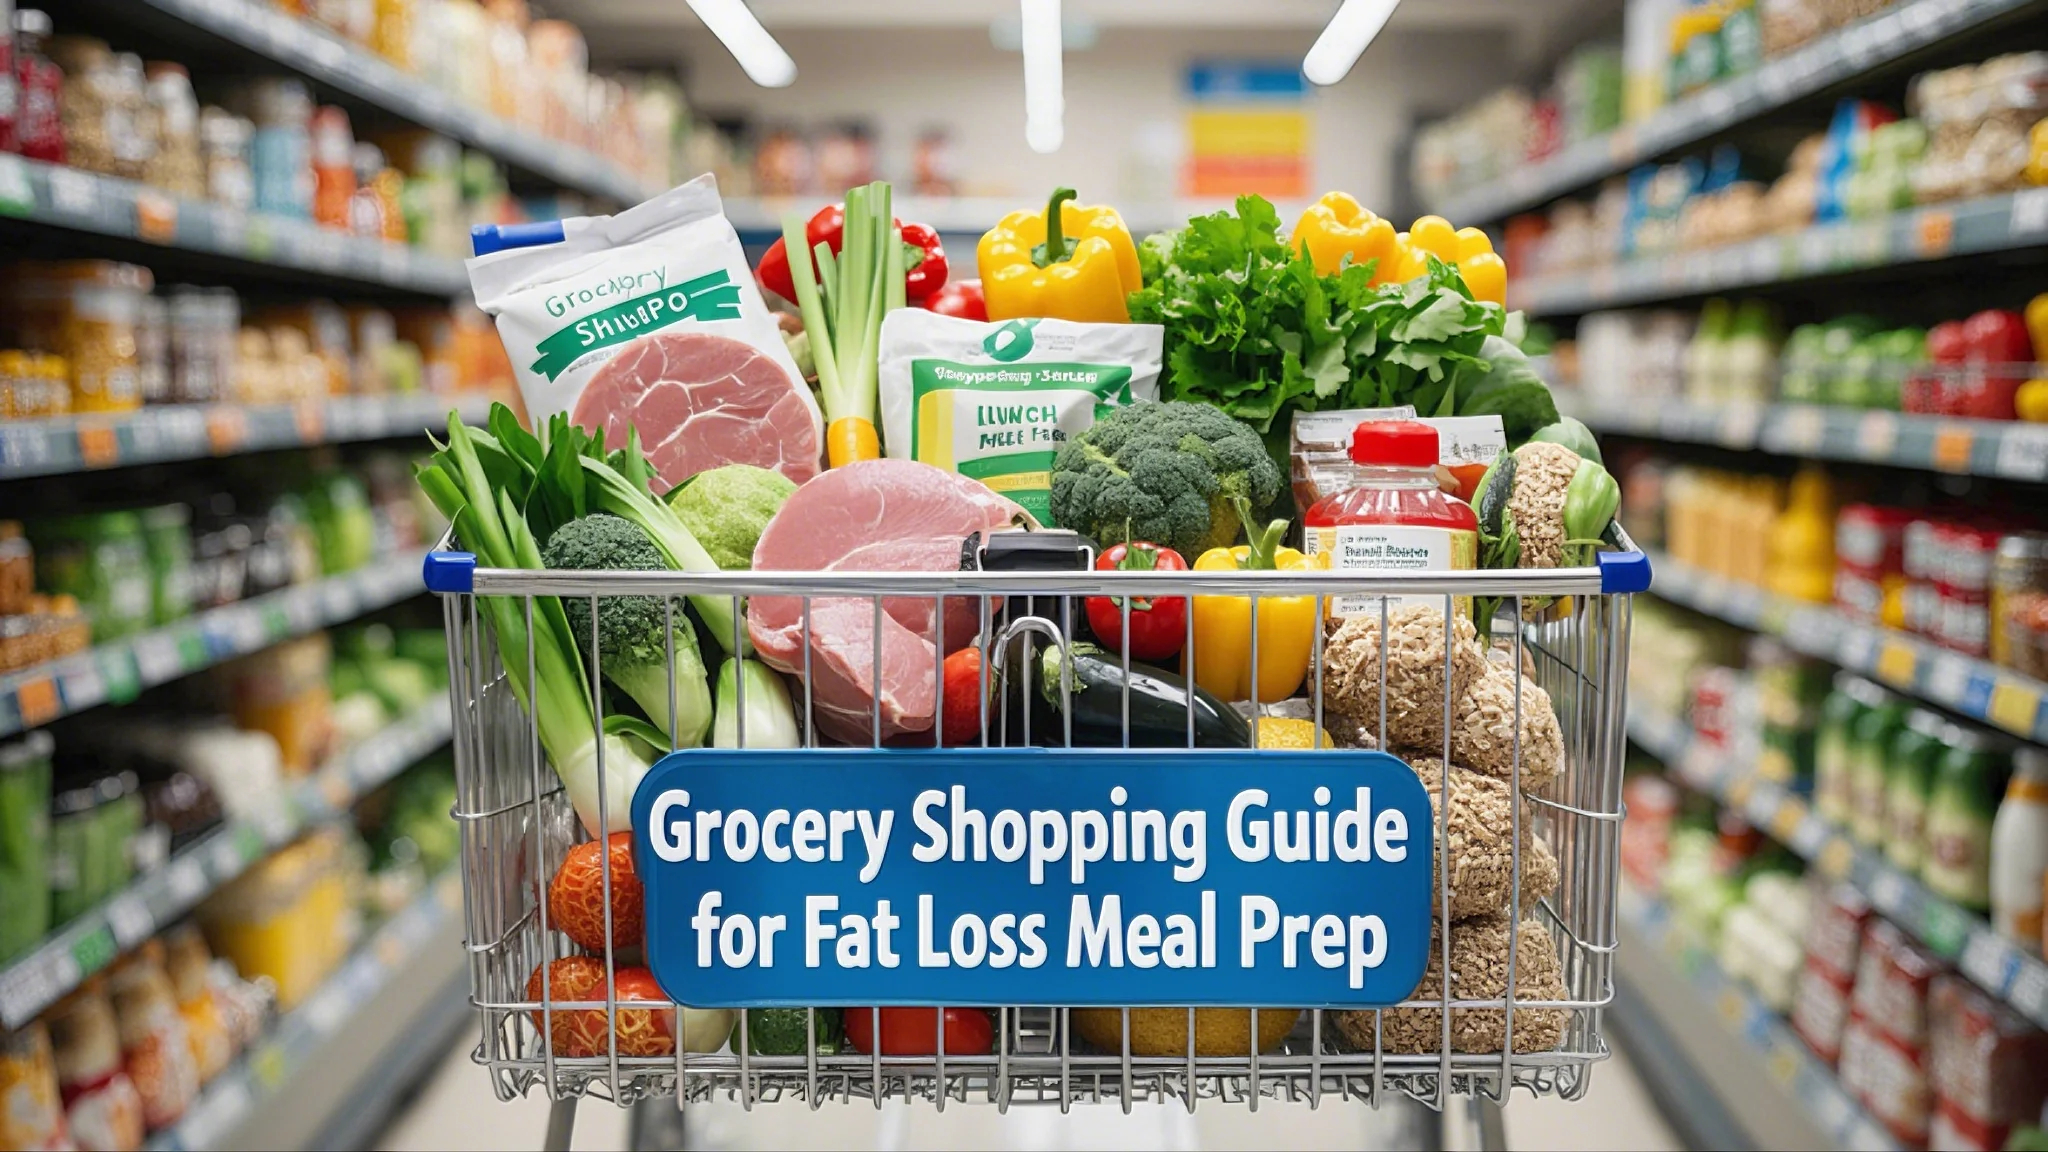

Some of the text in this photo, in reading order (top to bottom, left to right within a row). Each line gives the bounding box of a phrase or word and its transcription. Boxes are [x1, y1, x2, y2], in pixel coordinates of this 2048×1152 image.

[649, 784, 1409, 884] Grocery Shopping Guide
[692, 890, 1388, 989] for Fat Loss Meal Prep
